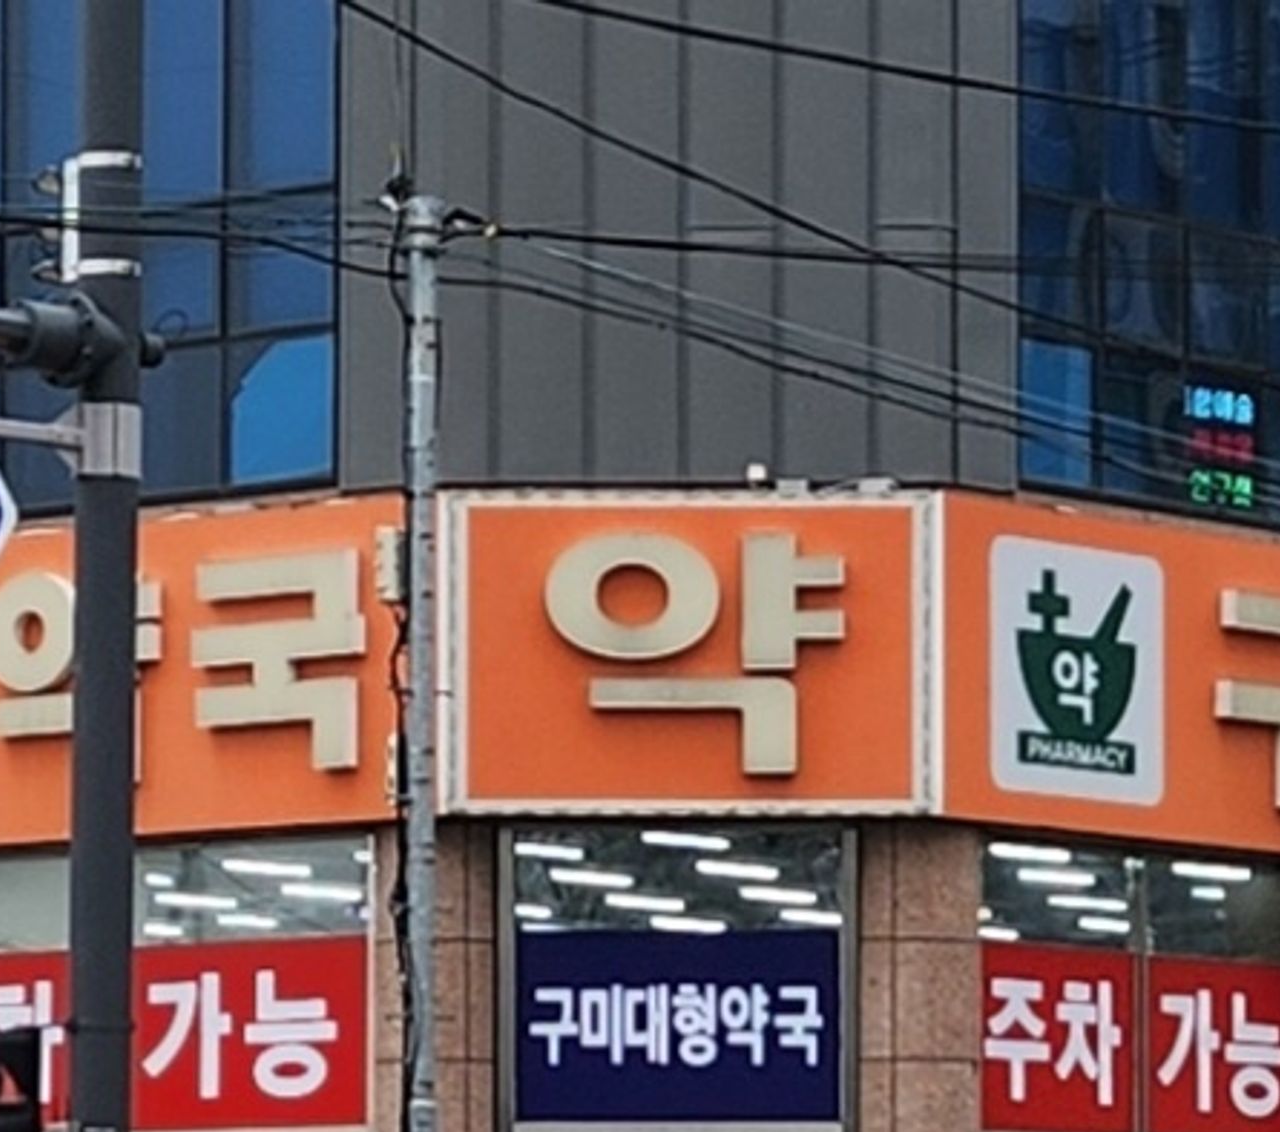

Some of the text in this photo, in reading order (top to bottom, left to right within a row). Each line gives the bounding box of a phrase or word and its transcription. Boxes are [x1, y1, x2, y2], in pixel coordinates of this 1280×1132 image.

[544, 526, 845, 776] 약
[1052, 650, 1100, 727] 약
[1026, 736, 1130, 771] PHARMACY
[142, 969, 339, 1099] 가능
[529, 983, 824, 1067] 구미대형약국
[984, 976, 1122, 1106] 주차
